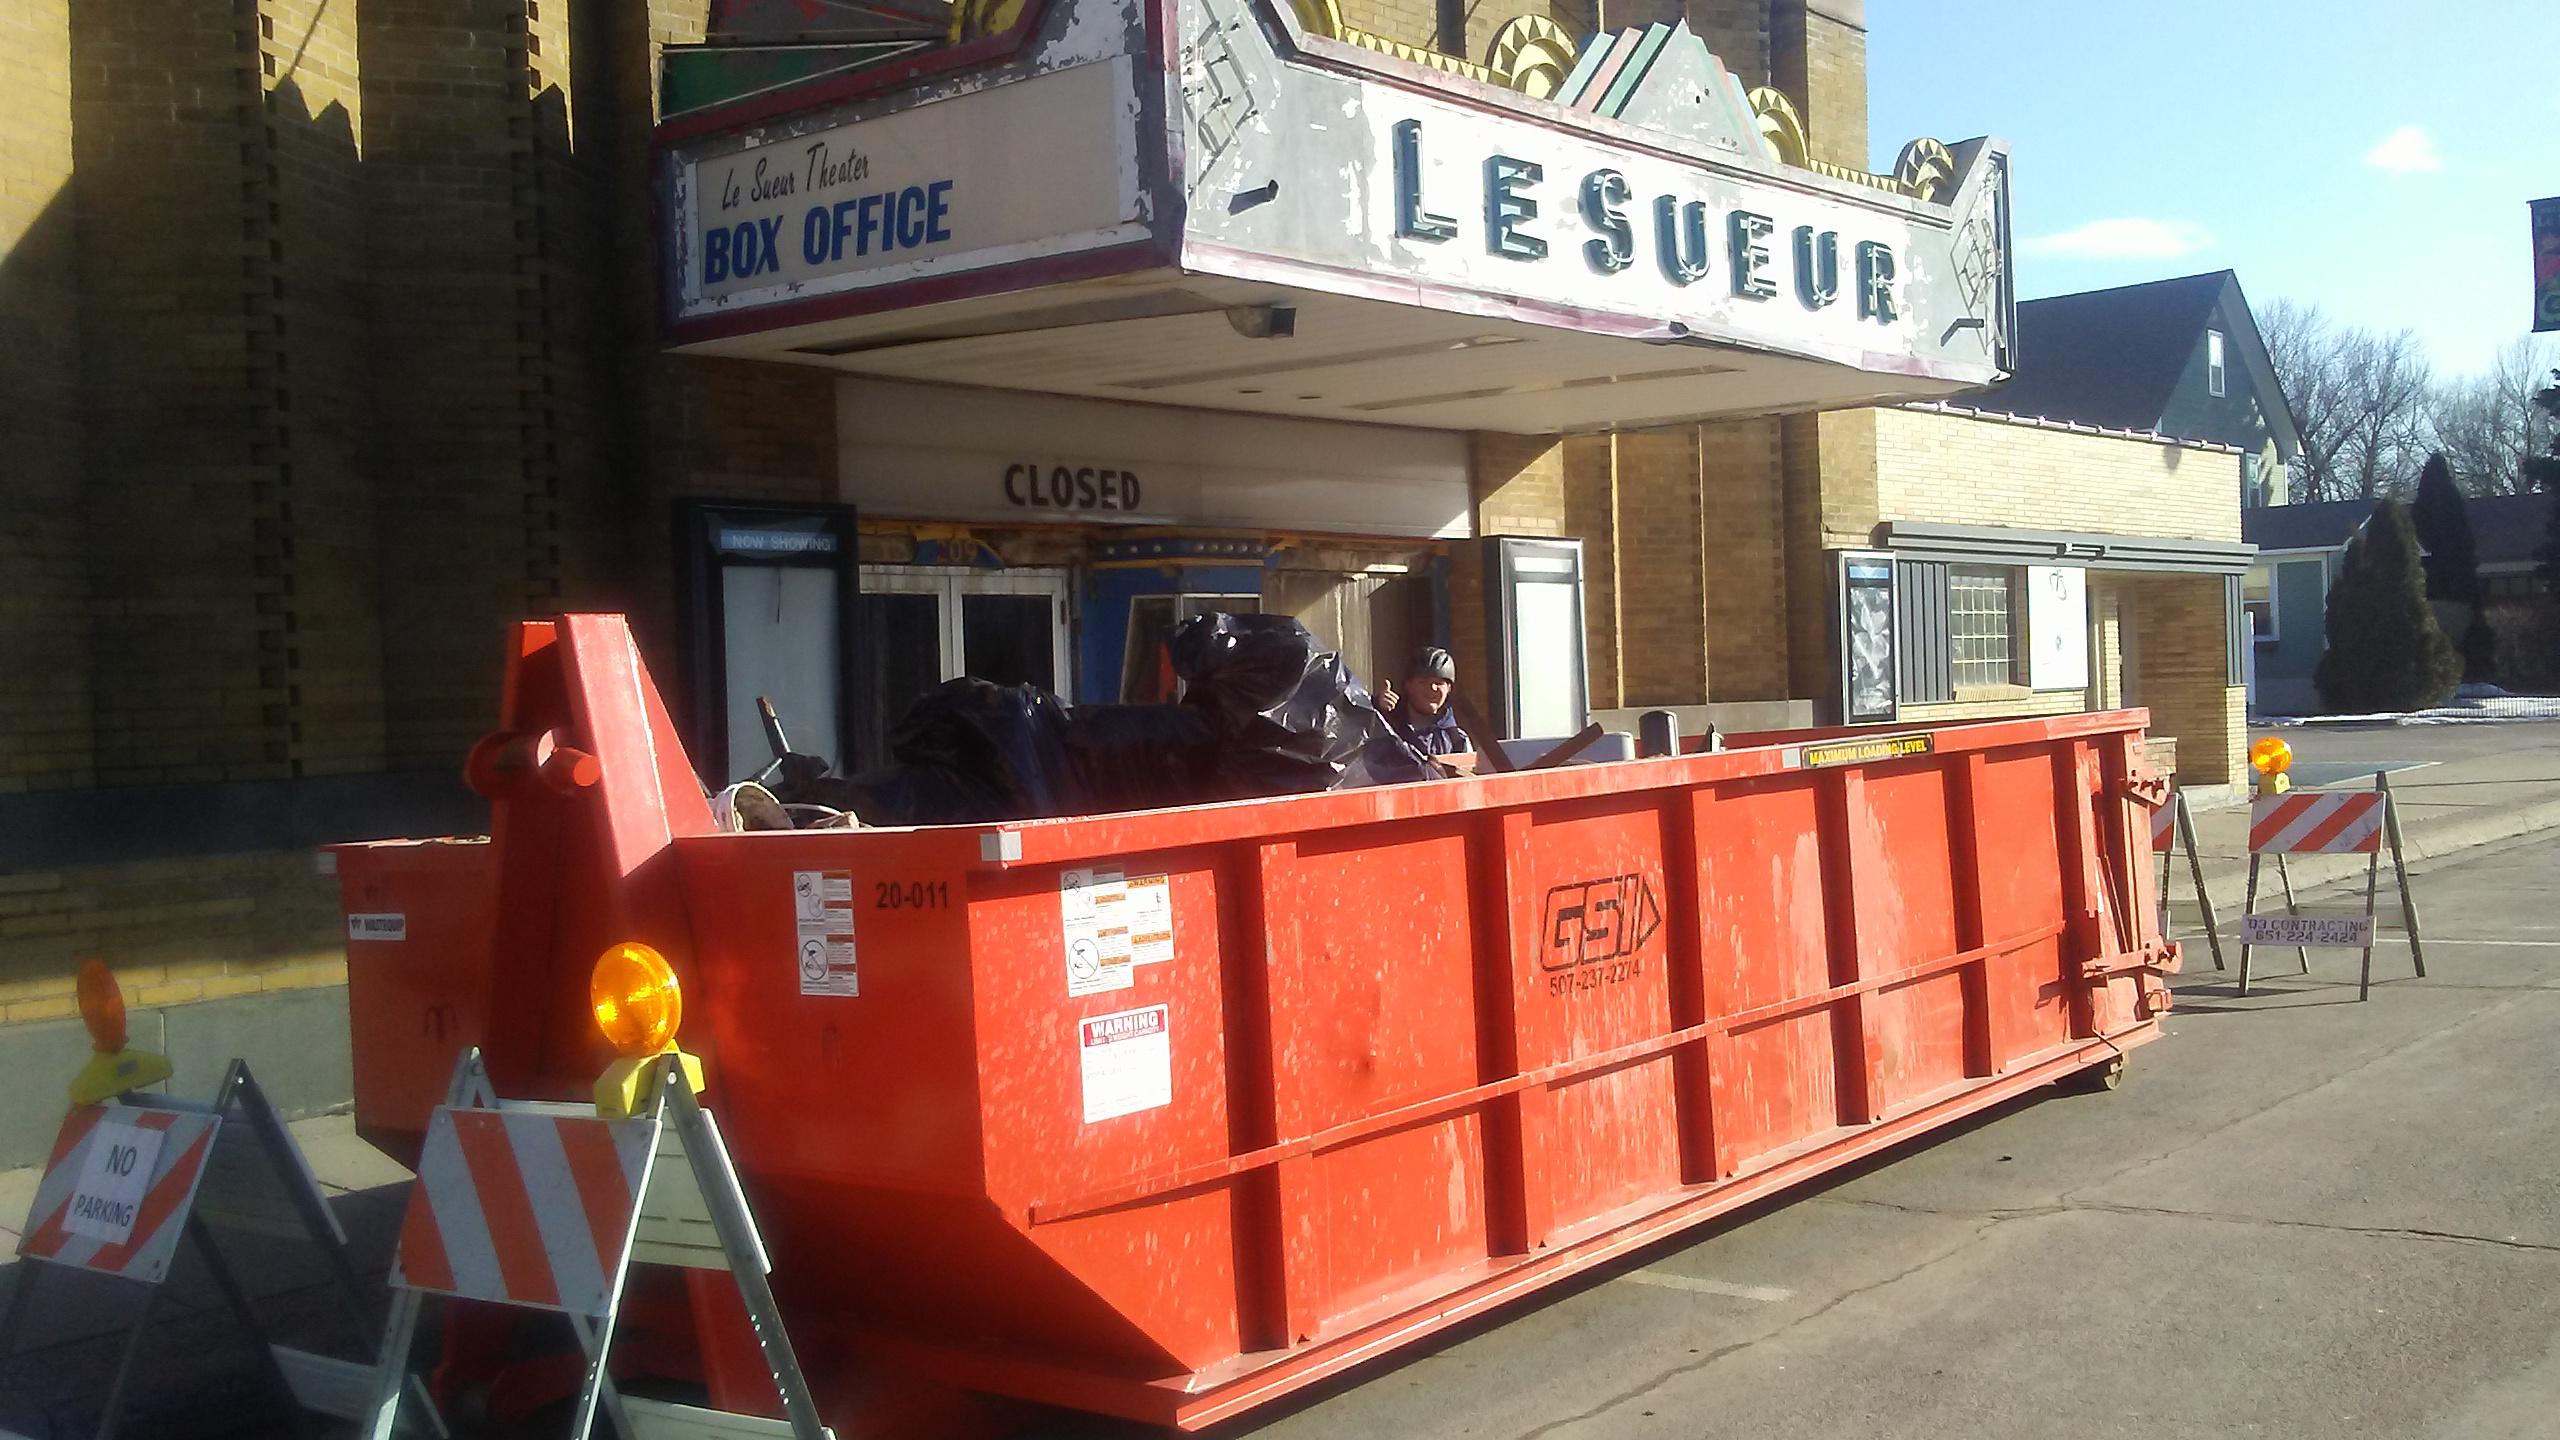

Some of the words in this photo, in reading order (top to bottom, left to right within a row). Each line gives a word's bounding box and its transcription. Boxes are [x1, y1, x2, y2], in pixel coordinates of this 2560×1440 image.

[722, 168, 740, 210] Le
[751, 157, 796, 202] Sueur
[806, 142, 870, 192] Theater
[704, 215, 784, 284] BOX
[803, 180, 953, 265] OFFICE
[1004, 463, 1142, 511] CLOSED
[732, 534, 764, 549] NOW
[770, 535, 832, 552] SHOWING
[1809, 746, 1857, 764] MAXIMUM
[1858, 743, 1898, 759] LOADING
[1900, 740, 1927, 754] LEVEL
[876, 880, 949, 909] 20-011
[2271, 919, 2369, 932] CONTRACTING
[1550, 959, 1641, 996] 507-237-2274
[1090, 1011, 1159, 1038] WARNING
[105, 1144, 137, 1177] NO
[74, 1195, 134, 1228] PARKING
